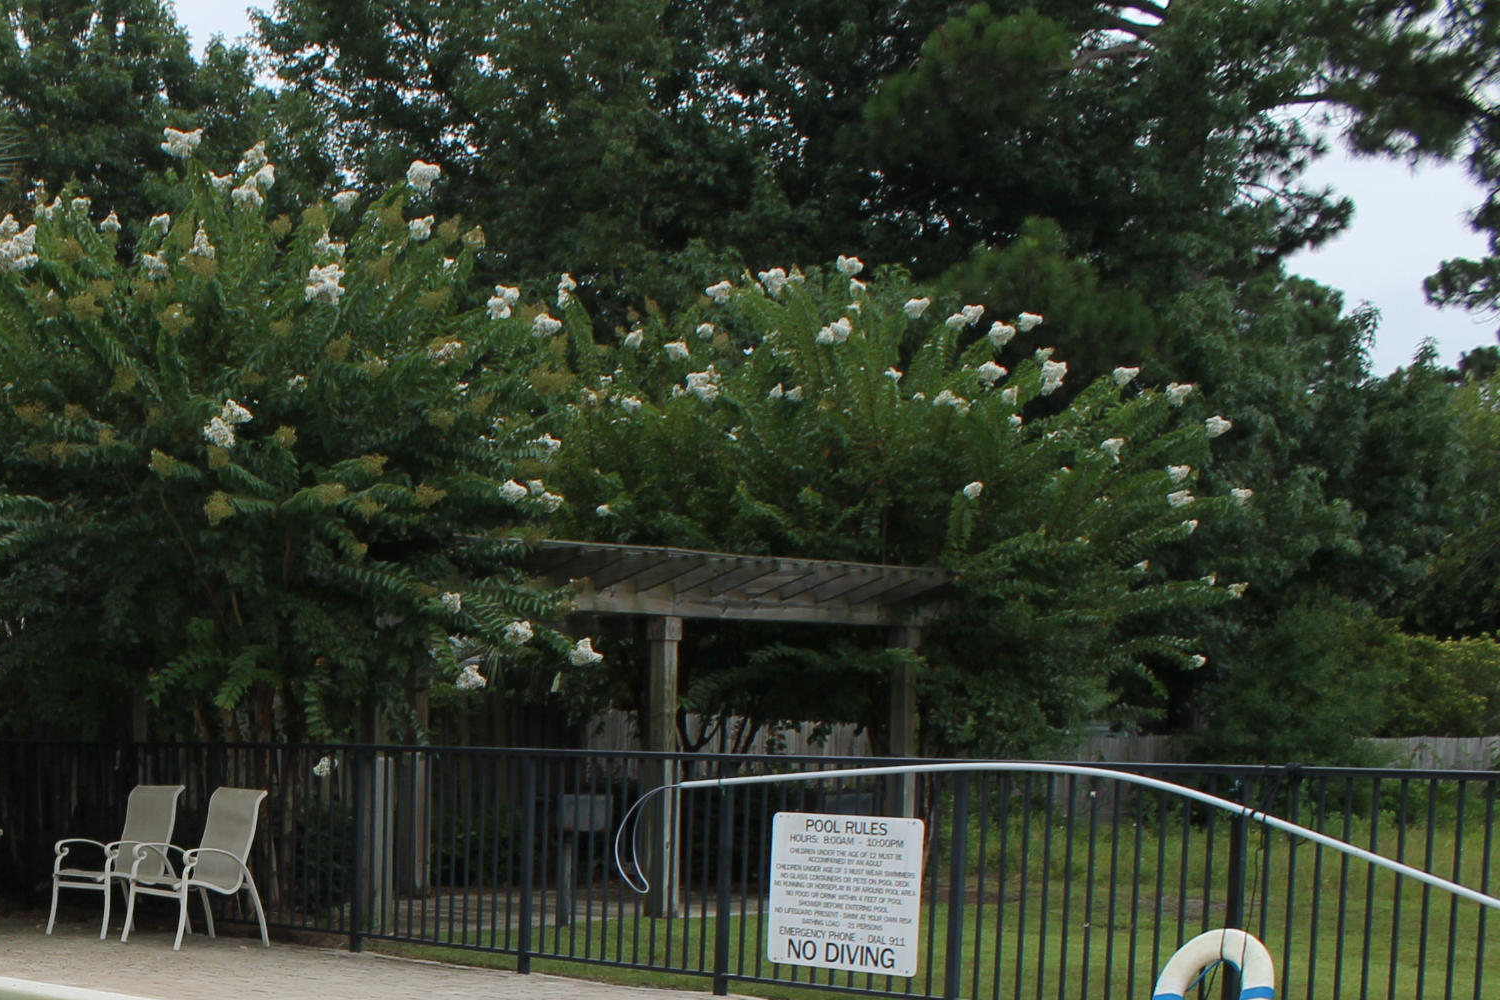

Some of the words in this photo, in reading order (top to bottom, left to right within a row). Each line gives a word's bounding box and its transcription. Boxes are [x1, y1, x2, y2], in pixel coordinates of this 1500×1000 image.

[805, 818, 841, 833] POOL
[845, 820, 888, 836] RULES
[823, 835, 854, 845] 8:00AM
[866, 837, 904, 848] 10:00PM
[779, 926, 826, 938] EMERGENCY
[828, 930, 855, 941] PHONE
[867, 934, 886, 944] DIAL
[888, 935, 905, 946] 911
[787, 938, 817, 961] NO
[824, 941, 895, 969] DIVING
